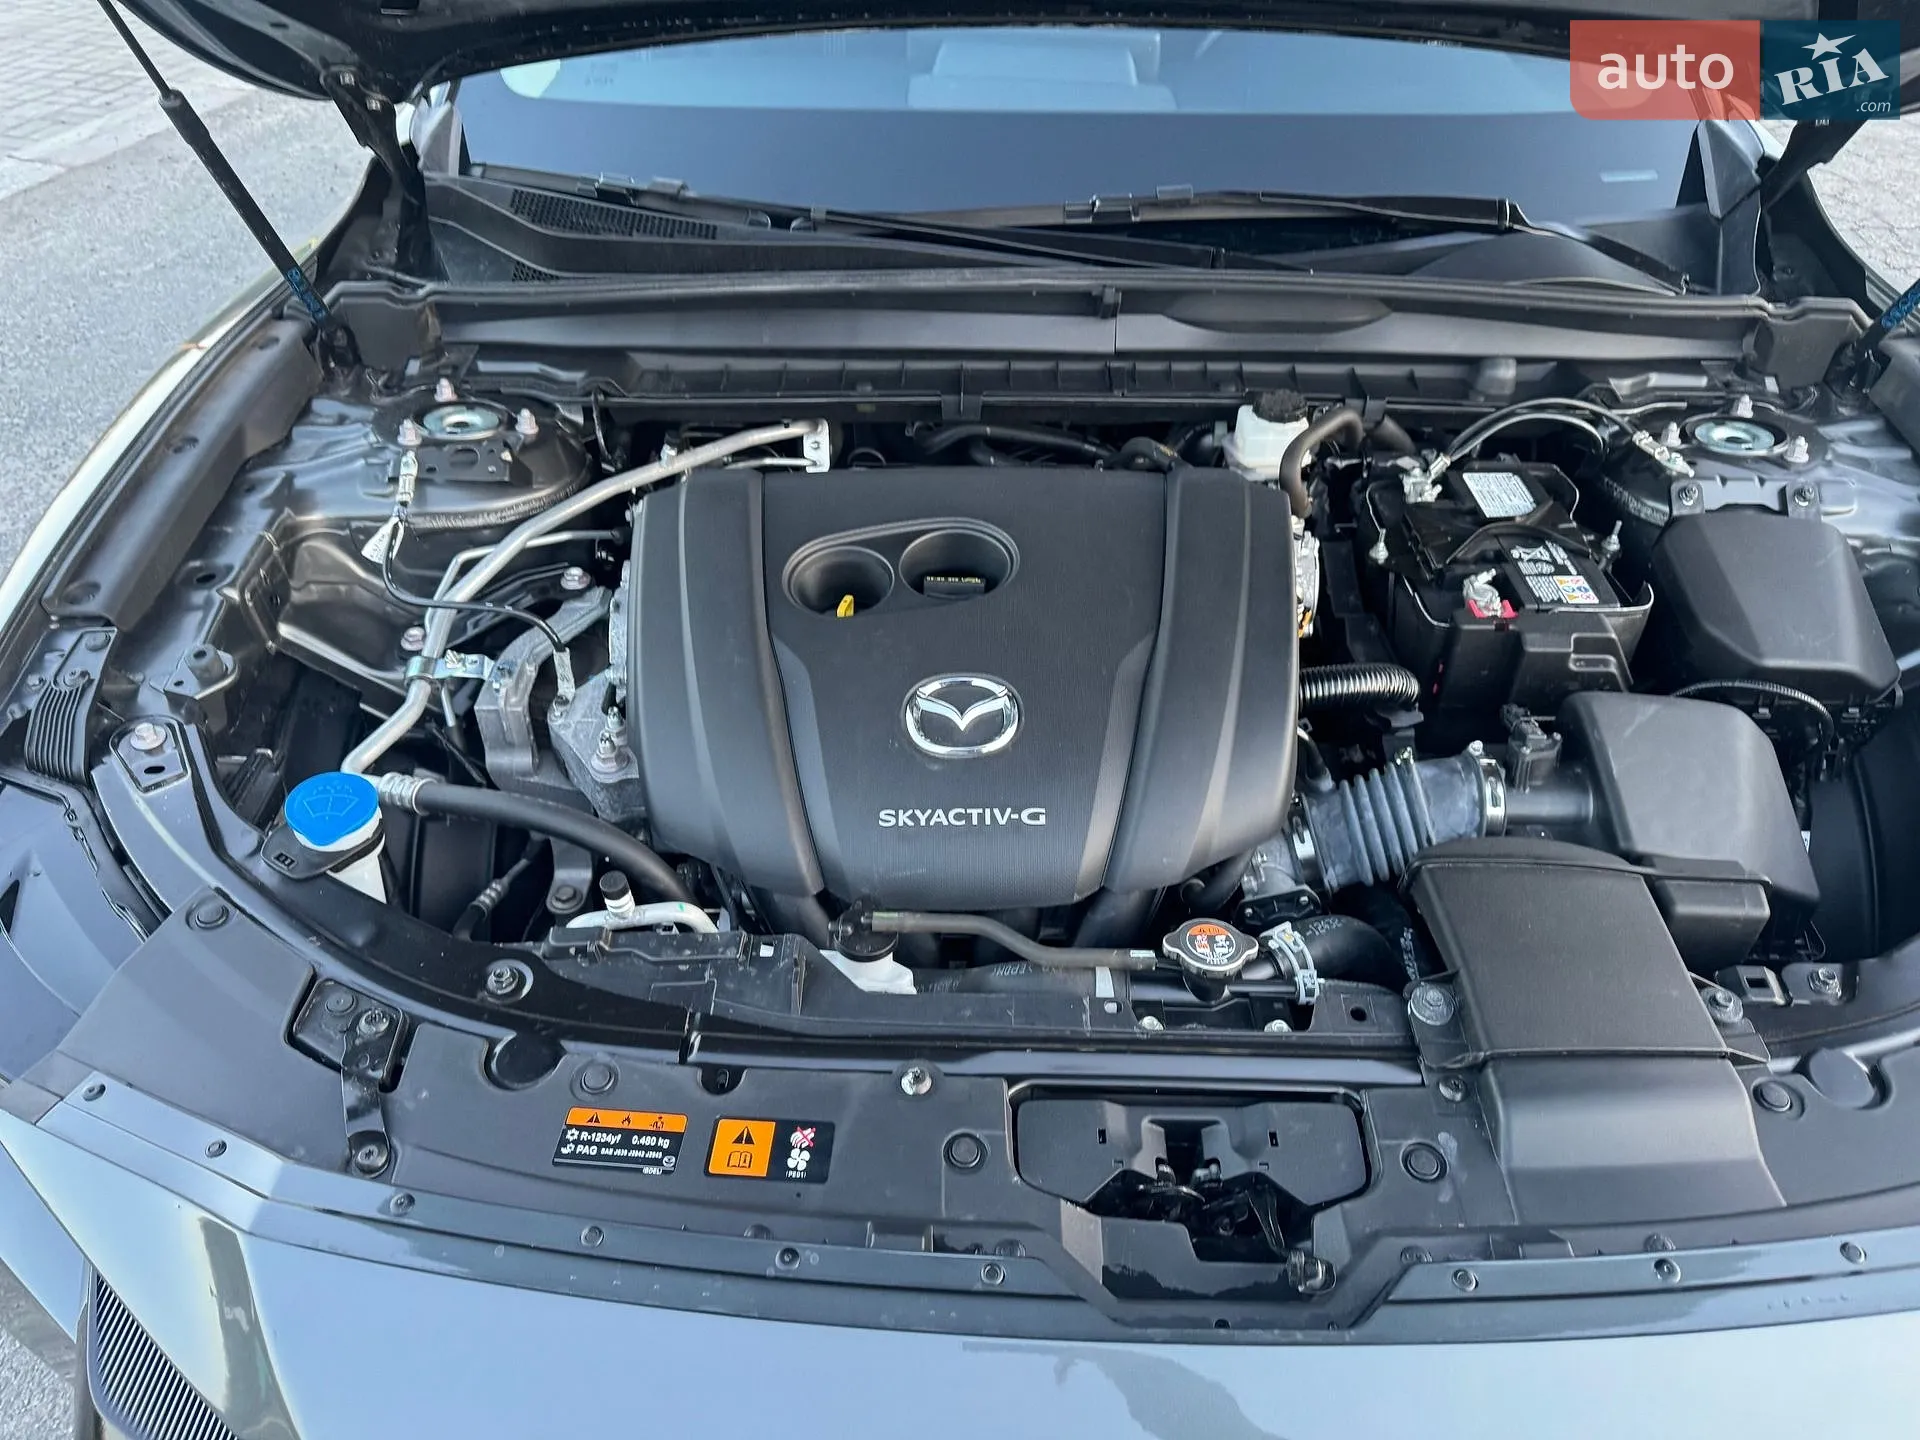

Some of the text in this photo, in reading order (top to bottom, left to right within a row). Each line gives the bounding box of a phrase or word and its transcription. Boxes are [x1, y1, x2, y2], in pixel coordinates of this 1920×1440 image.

[878, 807, 1046, 827] SKYACTIV-G
[580, 1131, 670, 1149] R-1234yf 0.480 kg
[576, 1144, 598, 1156] PAG
